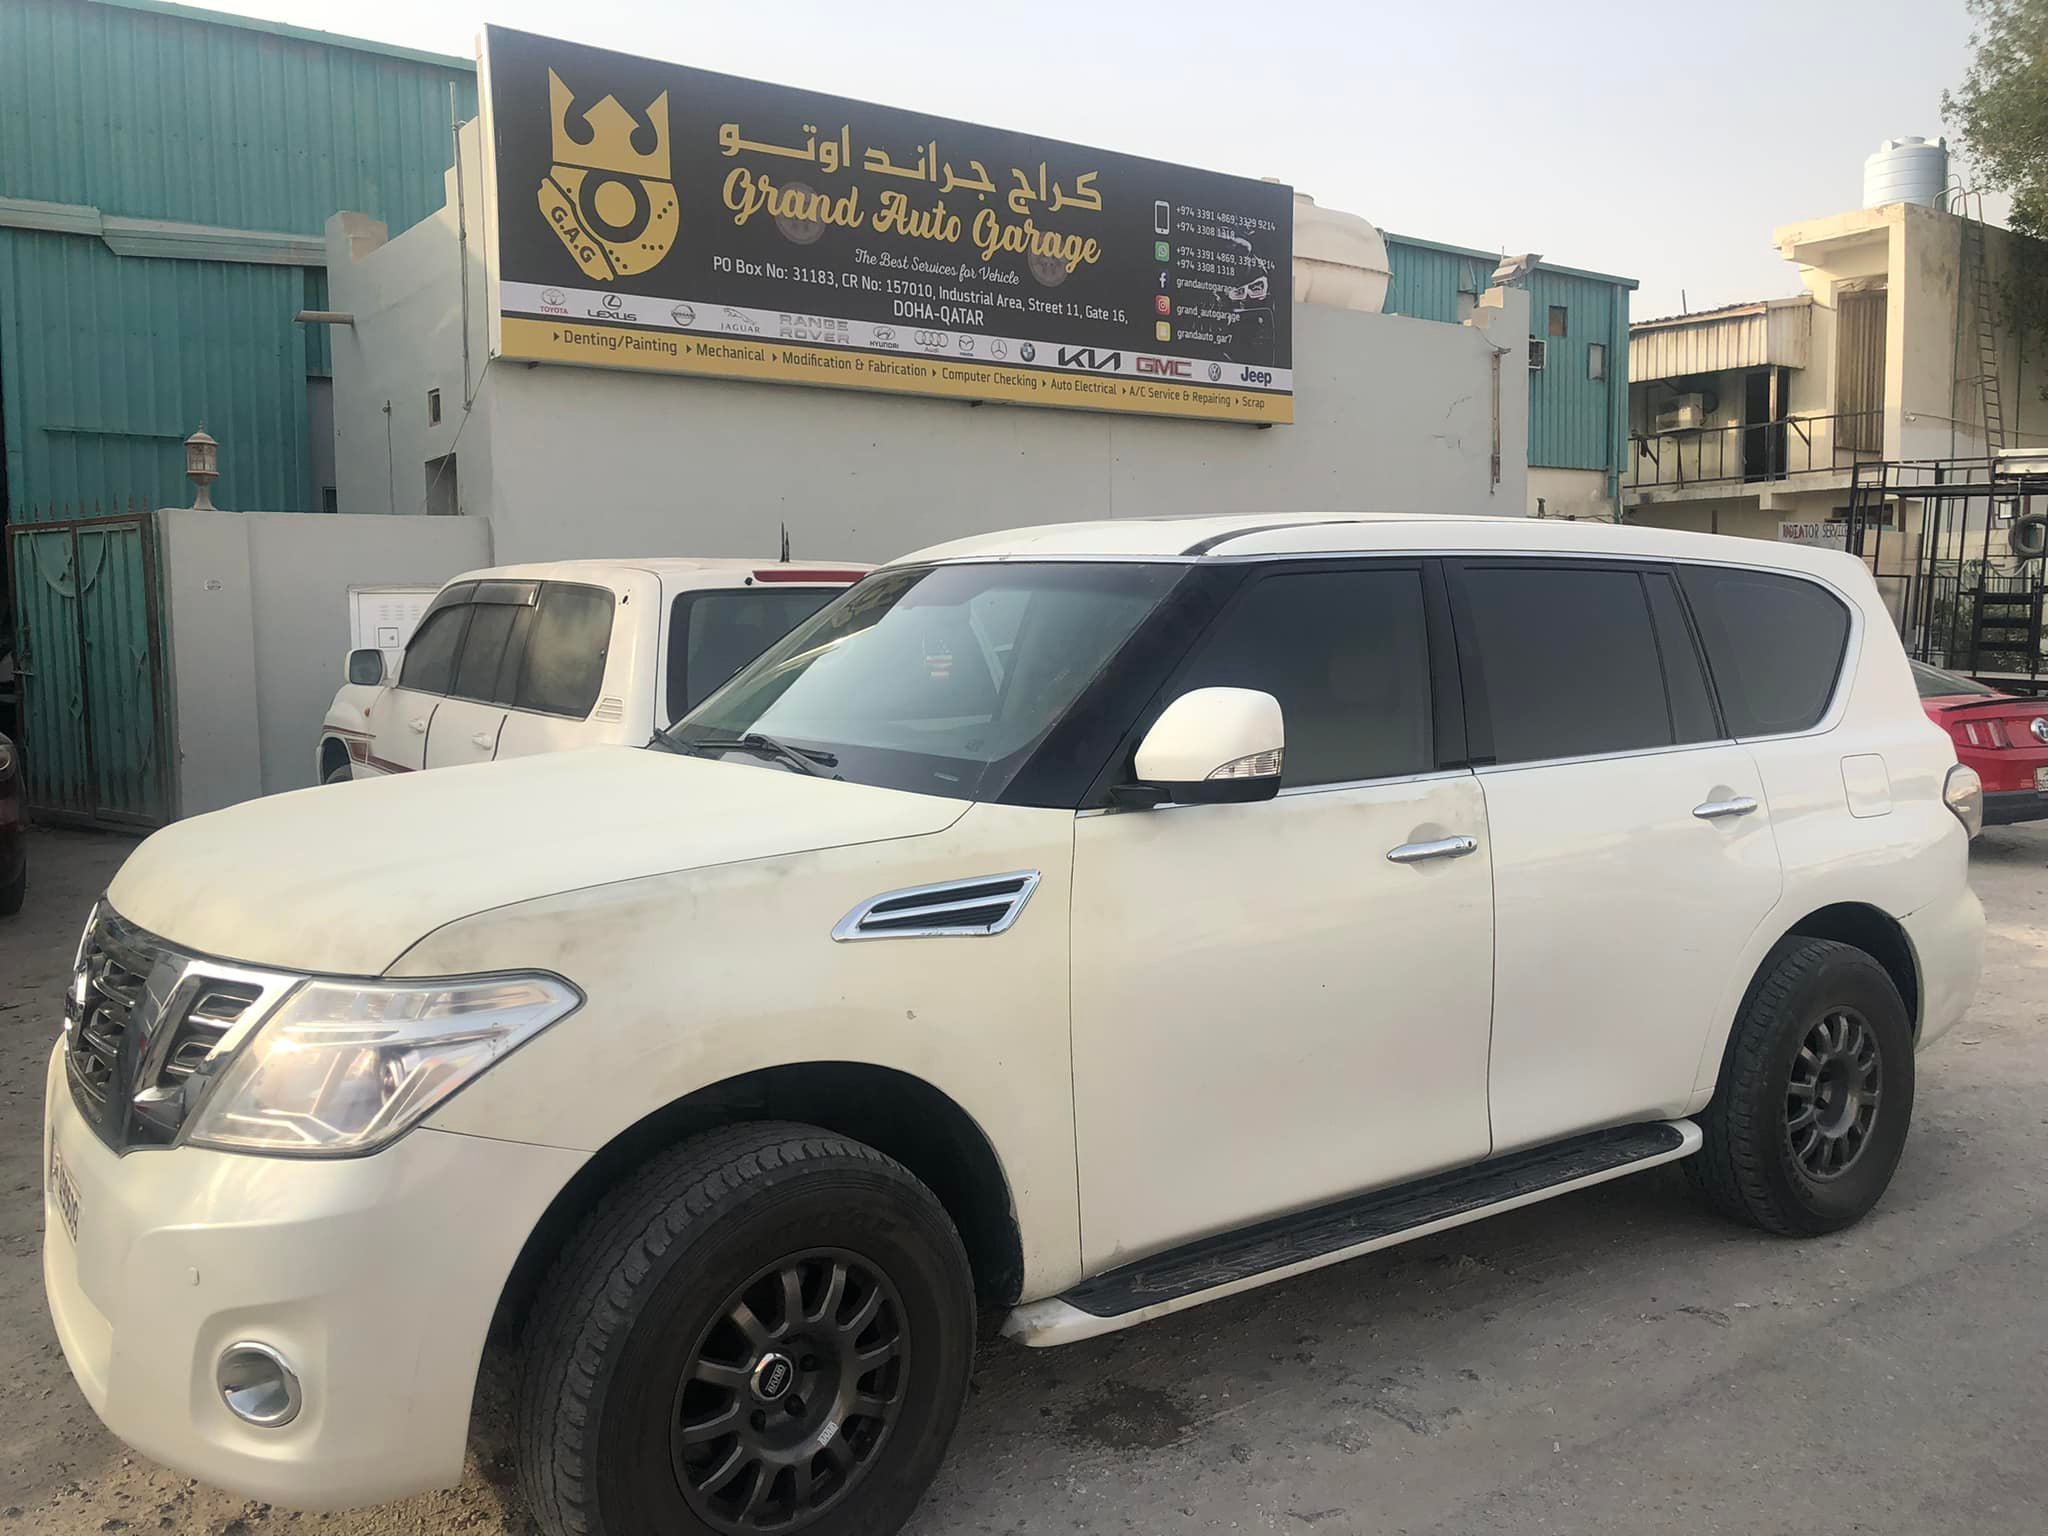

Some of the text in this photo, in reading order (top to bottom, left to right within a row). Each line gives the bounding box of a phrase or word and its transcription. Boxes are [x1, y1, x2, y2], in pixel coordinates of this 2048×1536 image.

[719, 123, 1102, 214] كراج جراند اوتو
[723, 167, 1101, 273] Grand Auto Garage
[1176, 206, 1195, 217] +974
[1197, 208, 1215, 220] 3391
[1258, 219, 1276, 231] 9214
[1176, 222, 1235, 240] +974 3308 1318
[1176, 246, 1195, 257] +974
[1197, 249, 1215, 260] 3391
[855, 248, 1019, 285] The Best Services for Vehicle
[1176, 260, 1235, 276] +974 3308 1318
[713, 256, 1128, 324] PO Box No: 31183, CR No: 157010, Industrial Area, Street 11, Gate 16,
[540, 306, 568, 315] TOYOTA
[587, 309, 637, 322] LEXUS
[893, 300, 984, 326] DOHA-QATAR
[721, 322, 761, 333] JAGUAR
[779, 314, 849, 331] RANGE
[779, 329, 850, 344] ROVER
[564, 330, 1265, 409] Denting/Painting Mechanical Modification & Fabrication Computer Checking Auto Electrical A/C Service & Repairing Scrap
[1136, 356, 1192, 377] GMC
[1240, 366, 1272, 387] Jeep
